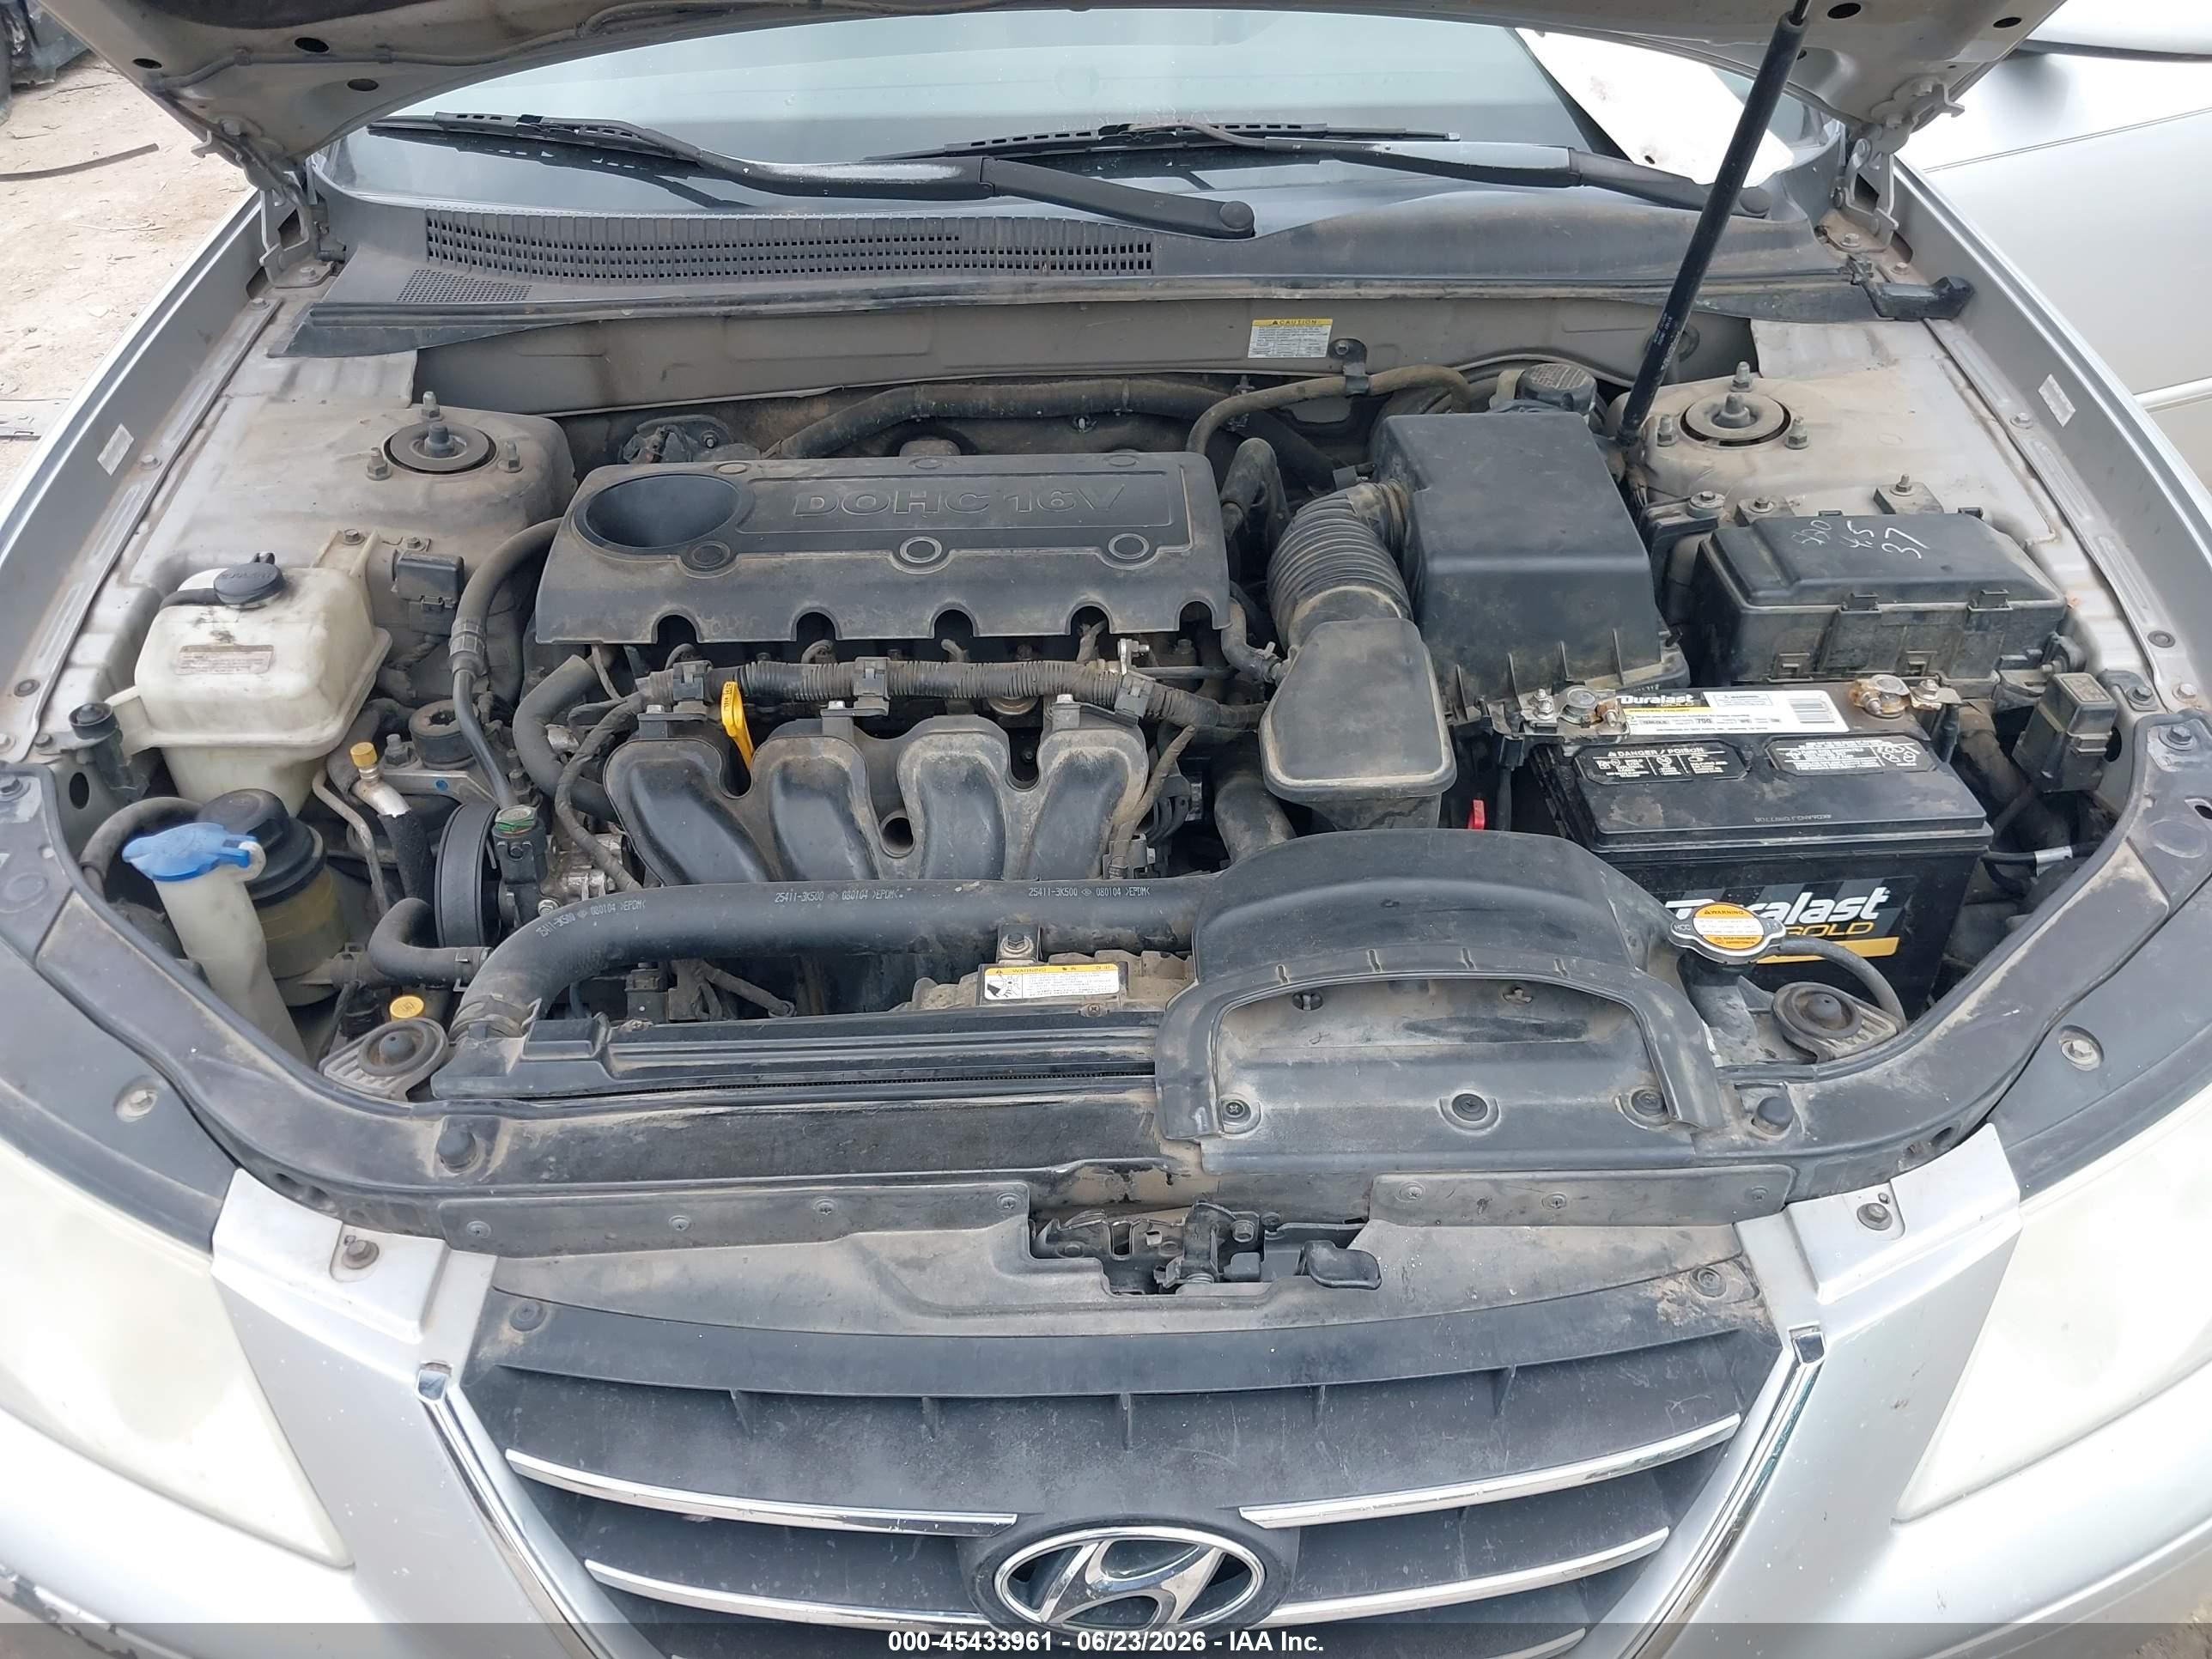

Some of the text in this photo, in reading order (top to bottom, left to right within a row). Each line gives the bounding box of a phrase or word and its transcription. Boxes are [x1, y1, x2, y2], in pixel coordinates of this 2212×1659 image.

[793, 484, 1126, 516] DOHC 16V
[1881, 527, 1931, 559] 37
[1616, 694, 1694, 704] Duralast
[1029, 887, 1078, 896] 25411-3K500
[1096, 887, 1121, 896] 080104
